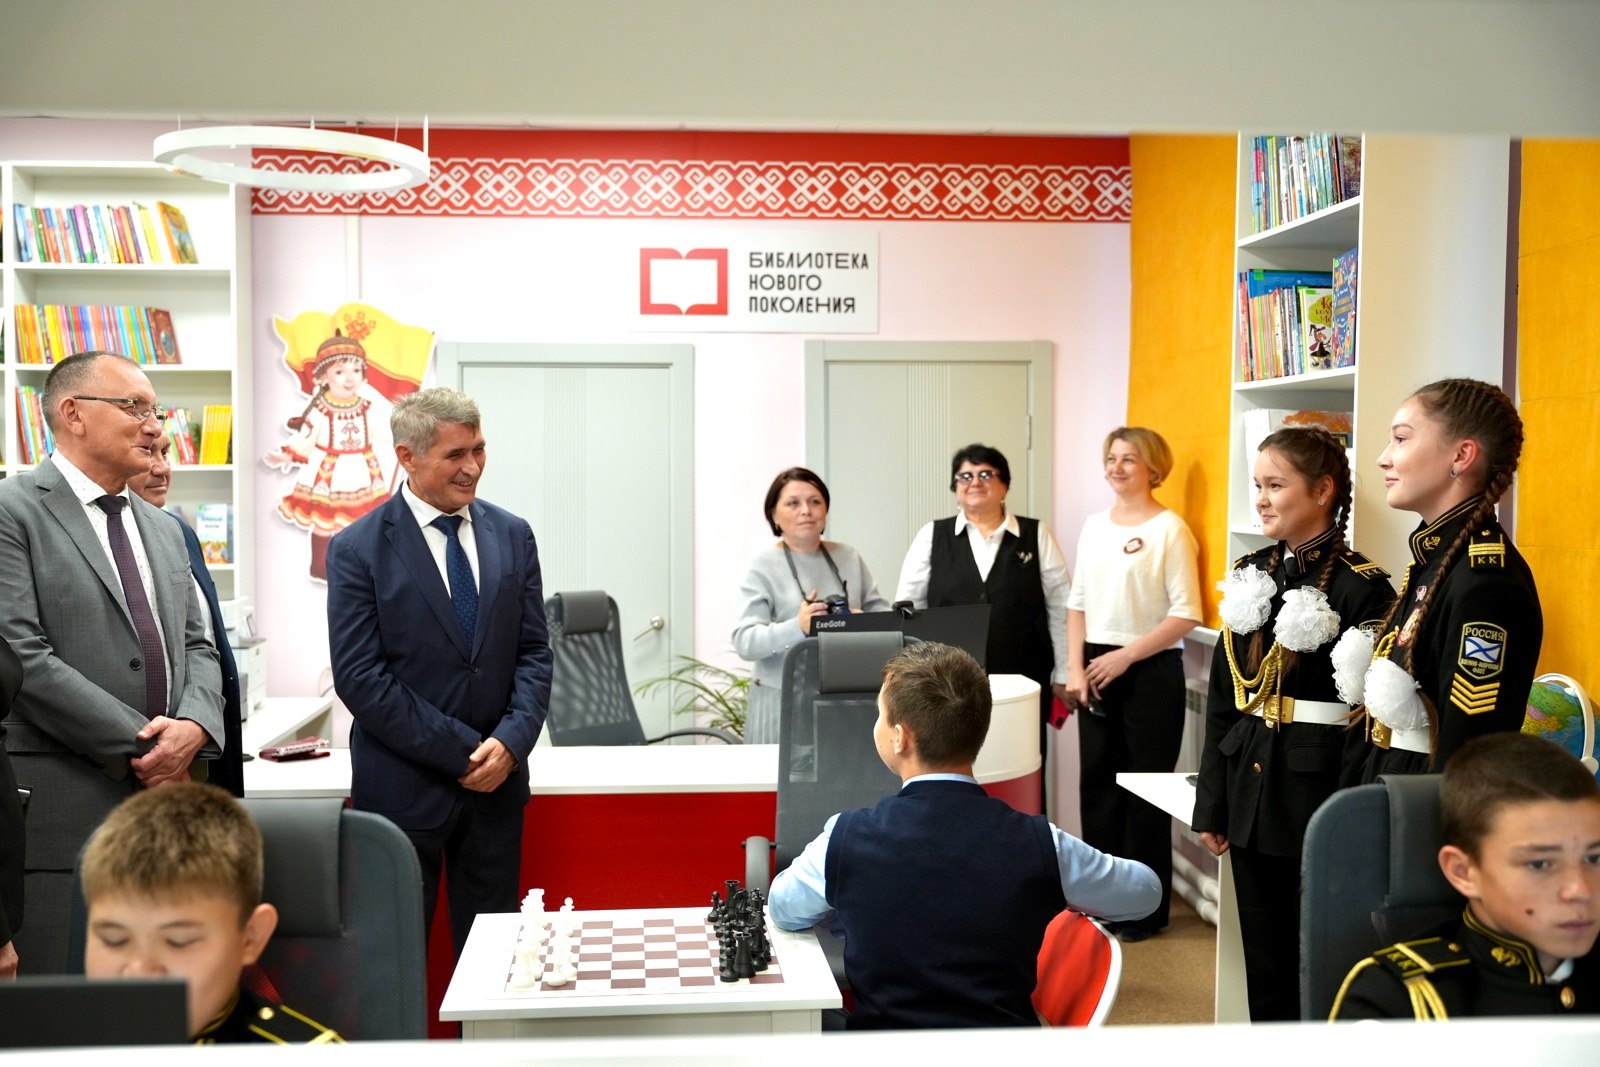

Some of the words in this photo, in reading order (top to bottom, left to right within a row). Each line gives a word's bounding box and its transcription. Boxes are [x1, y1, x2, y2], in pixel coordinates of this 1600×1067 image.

[749, 252, 869, 269] БИБЛИОТЕКА
[749, 274, 822, 291] НОВОГО
[749, 296, 856, 313] ПОКОЛЕНИЯ
[815, 620, 846, 628] ExeGate
[1465, 626, 1504, 641] РОССИЯ
